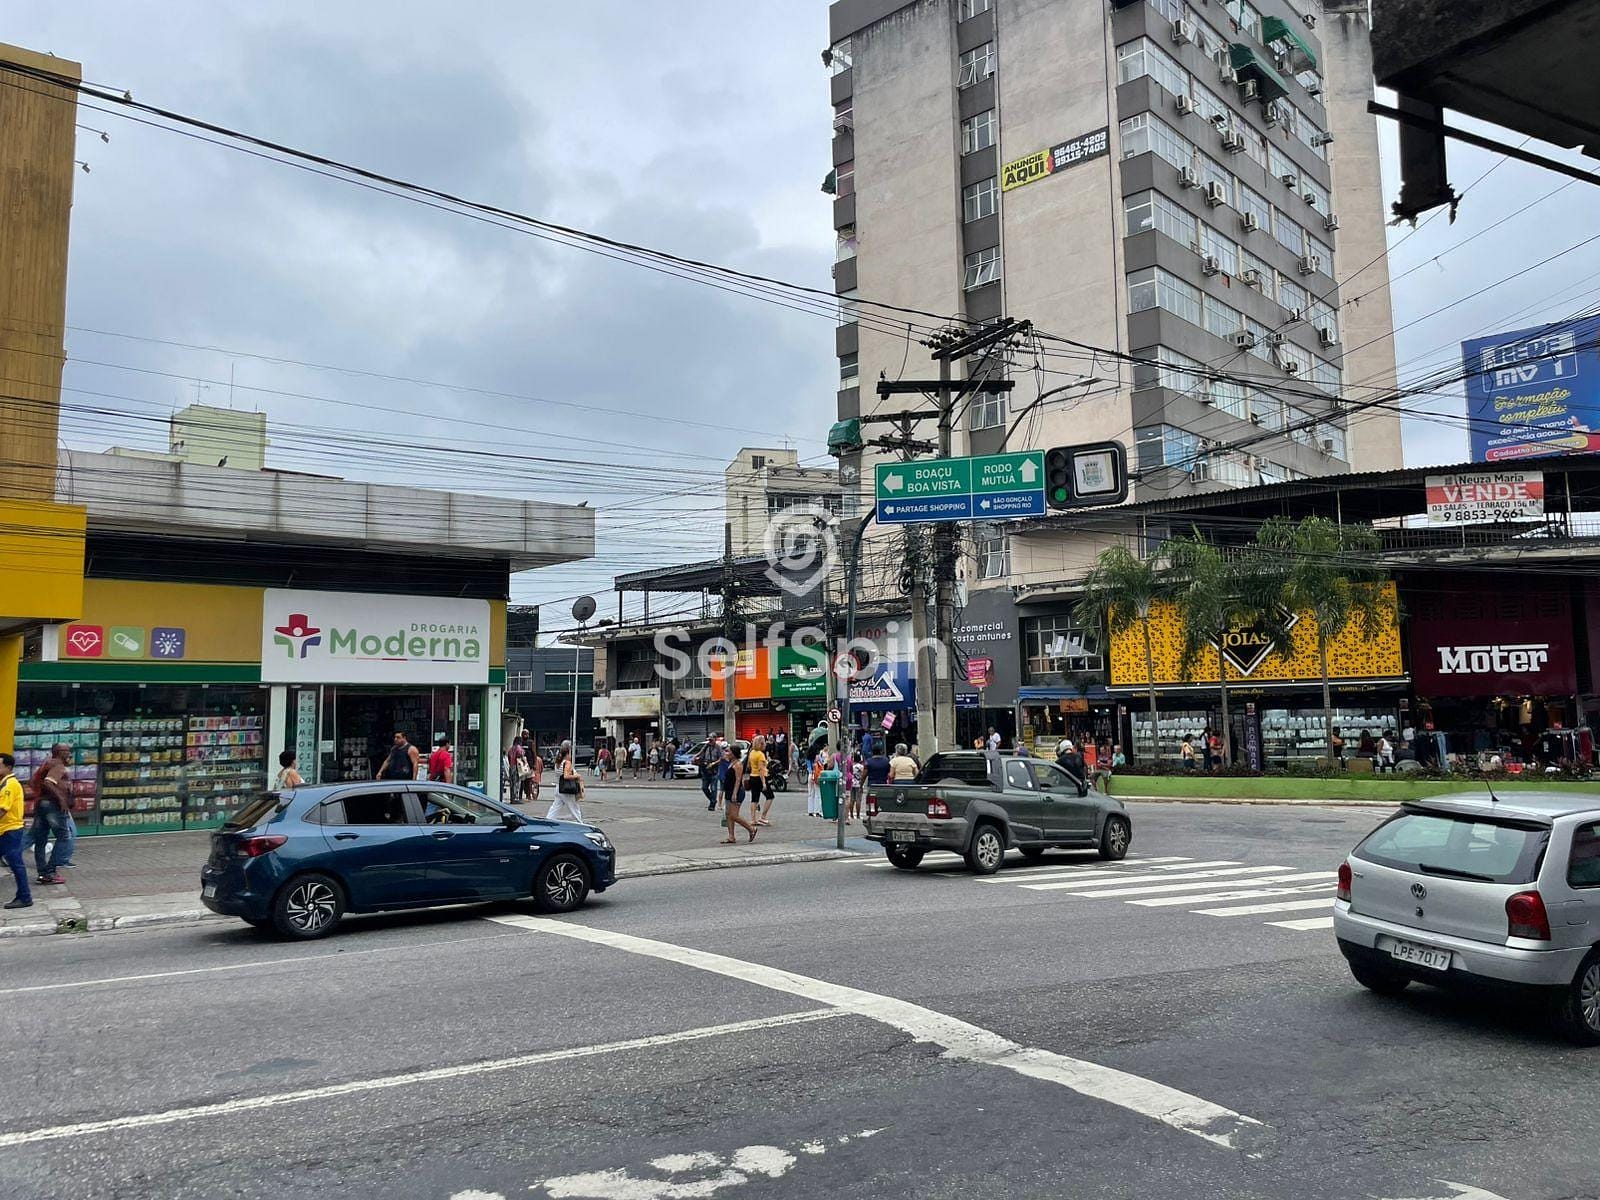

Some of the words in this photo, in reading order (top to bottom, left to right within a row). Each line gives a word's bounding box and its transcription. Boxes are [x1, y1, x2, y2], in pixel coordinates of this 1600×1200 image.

[1004, 153, 1044, 174] ANUNCIE
[1004, 162, 1045, 186] AQUI
[1494, 387, 1572, 412] Formação
[915, 467, 952, 479] BOAÇU
[983, 463, 1013, 474] RODO
[981, 472, 1015, 486] MUTUÁ
[1459, 475, 1492, 485] Neuza
[1494, 473, 1524, 483] Maria
[907, 483, 930, 493] BOA
[931, 480, 961, 491] VISTA
[1442, 483, 1528, 502] VENDE
[993, 496, 1005, 504] SÃO
[993, 502, 1021, 510] SHOPPING
[896, 504, 929, 513] PARTAGE
[929, 503, 966, 512] SHOPPING
[1443, 503, 1467, 511] SALAS
[1443, 511, 1452, 522] 9
[410, 623, 479, 635] DROGARIA
[960, 621, 1004, 633] comercial
[329, 627, 481, 658] Moderna
[976, 632, 1013, 644] antunes
[1437, 643, 1550, 674] Moter
